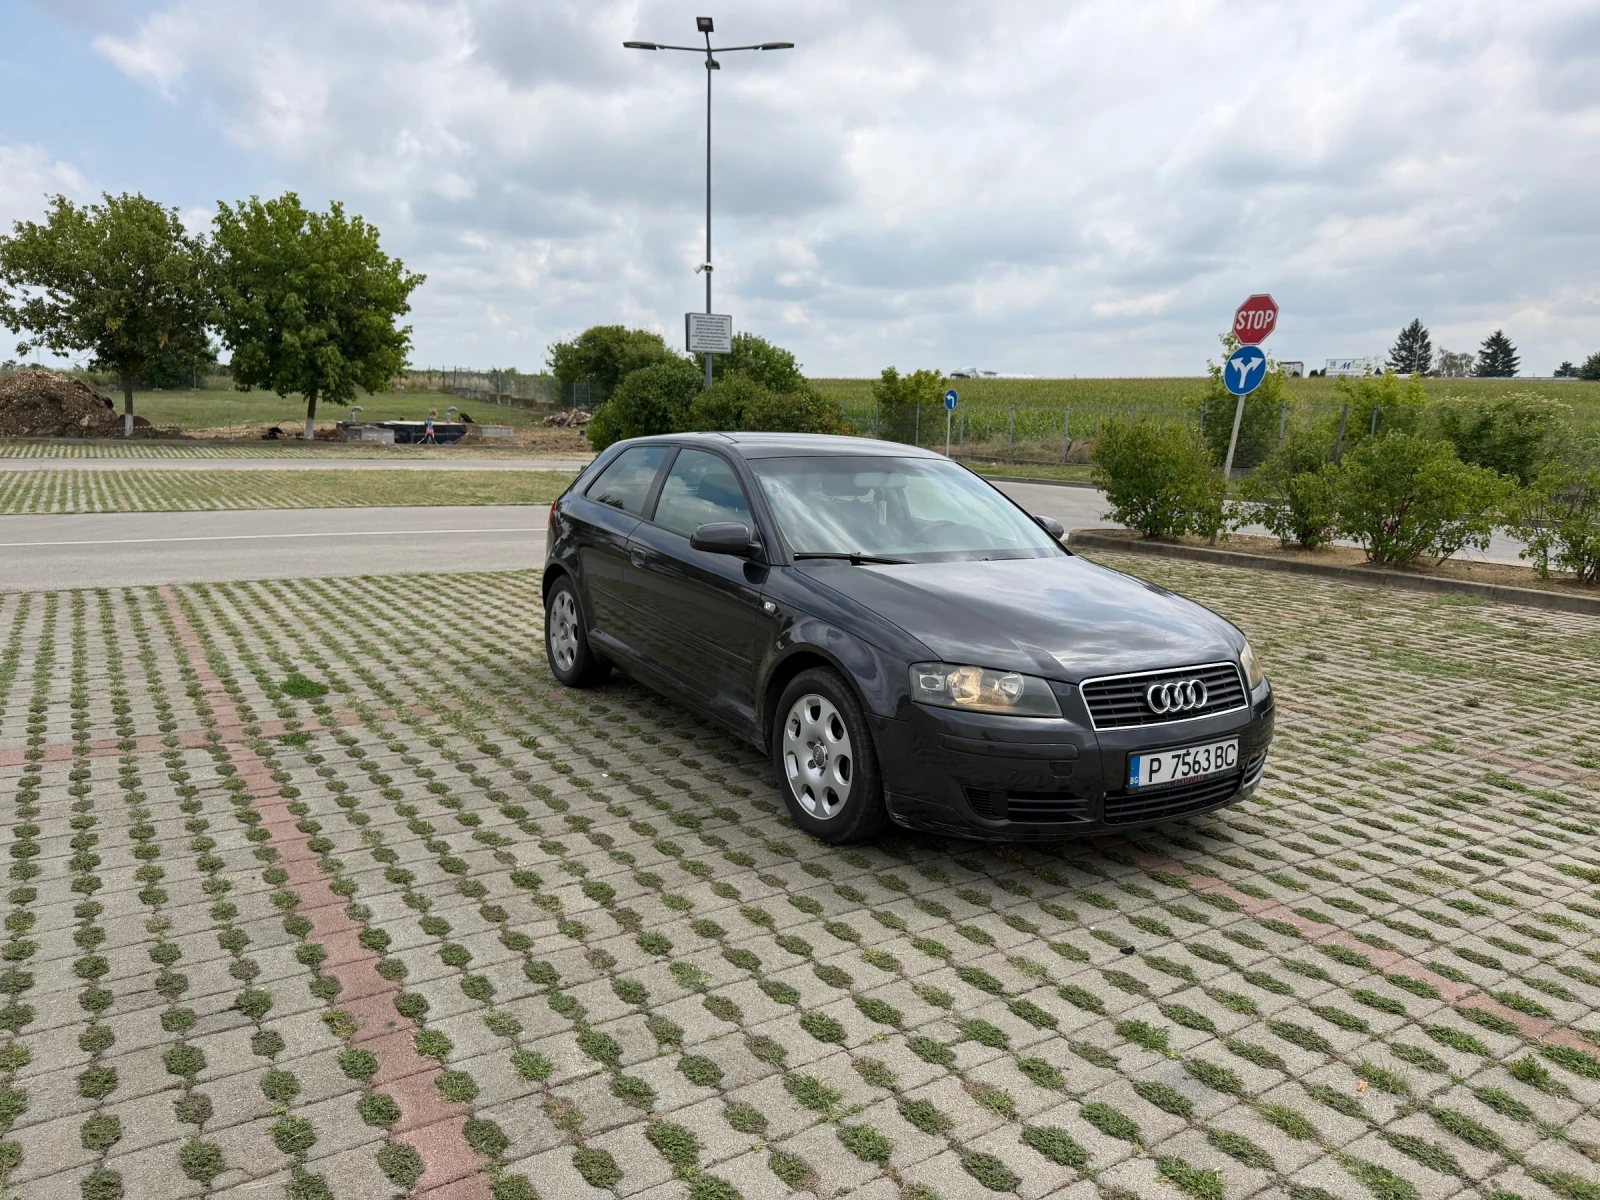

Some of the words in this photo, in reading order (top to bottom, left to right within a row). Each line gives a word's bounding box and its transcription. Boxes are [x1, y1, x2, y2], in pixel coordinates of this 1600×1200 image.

[1236, 310, 1274, 330] STOP
[1149, 757, 1162, 782] P
[1171, 749, 1211, 779] 7563
[1215, 743, 1236, 770] BC
